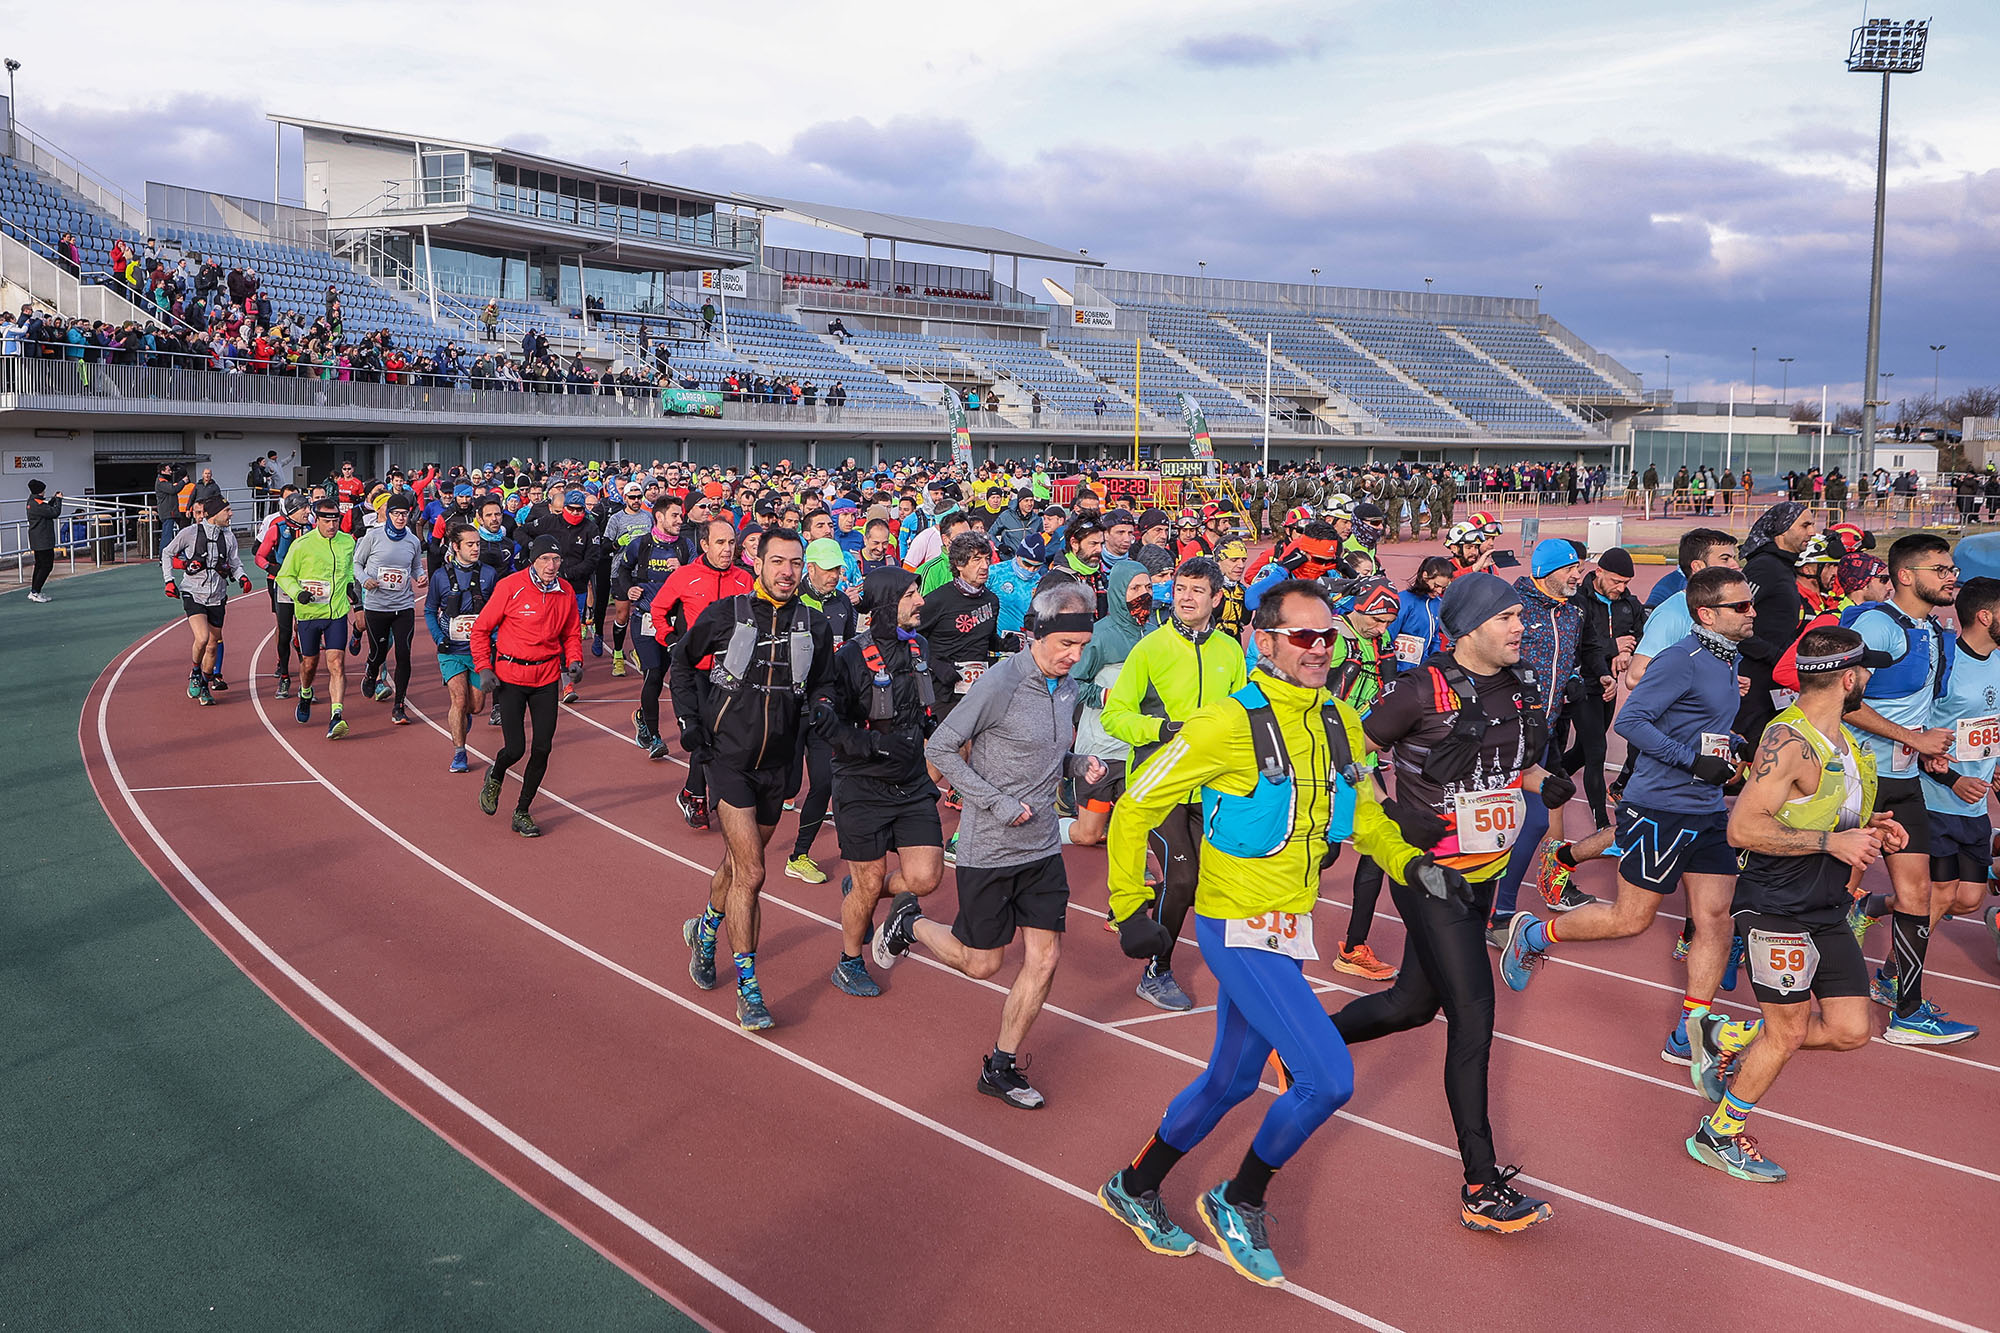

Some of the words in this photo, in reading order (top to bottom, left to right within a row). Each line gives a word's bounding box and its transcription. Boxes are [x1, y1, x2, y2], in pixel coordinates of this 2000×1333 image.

[1084, 310, 1109, 319] GOBIERNO
[676, 392, 707, 403] CARRERA
[686, 403, 698, 413] DEL
[383, 573, 403, 584] 592
[456, 622, 472, 632] 53
[1968, 727, 2000, 747] 685
[1475, 806, 1516, 832] 501
[1770, 948, 1805, 971] 59
